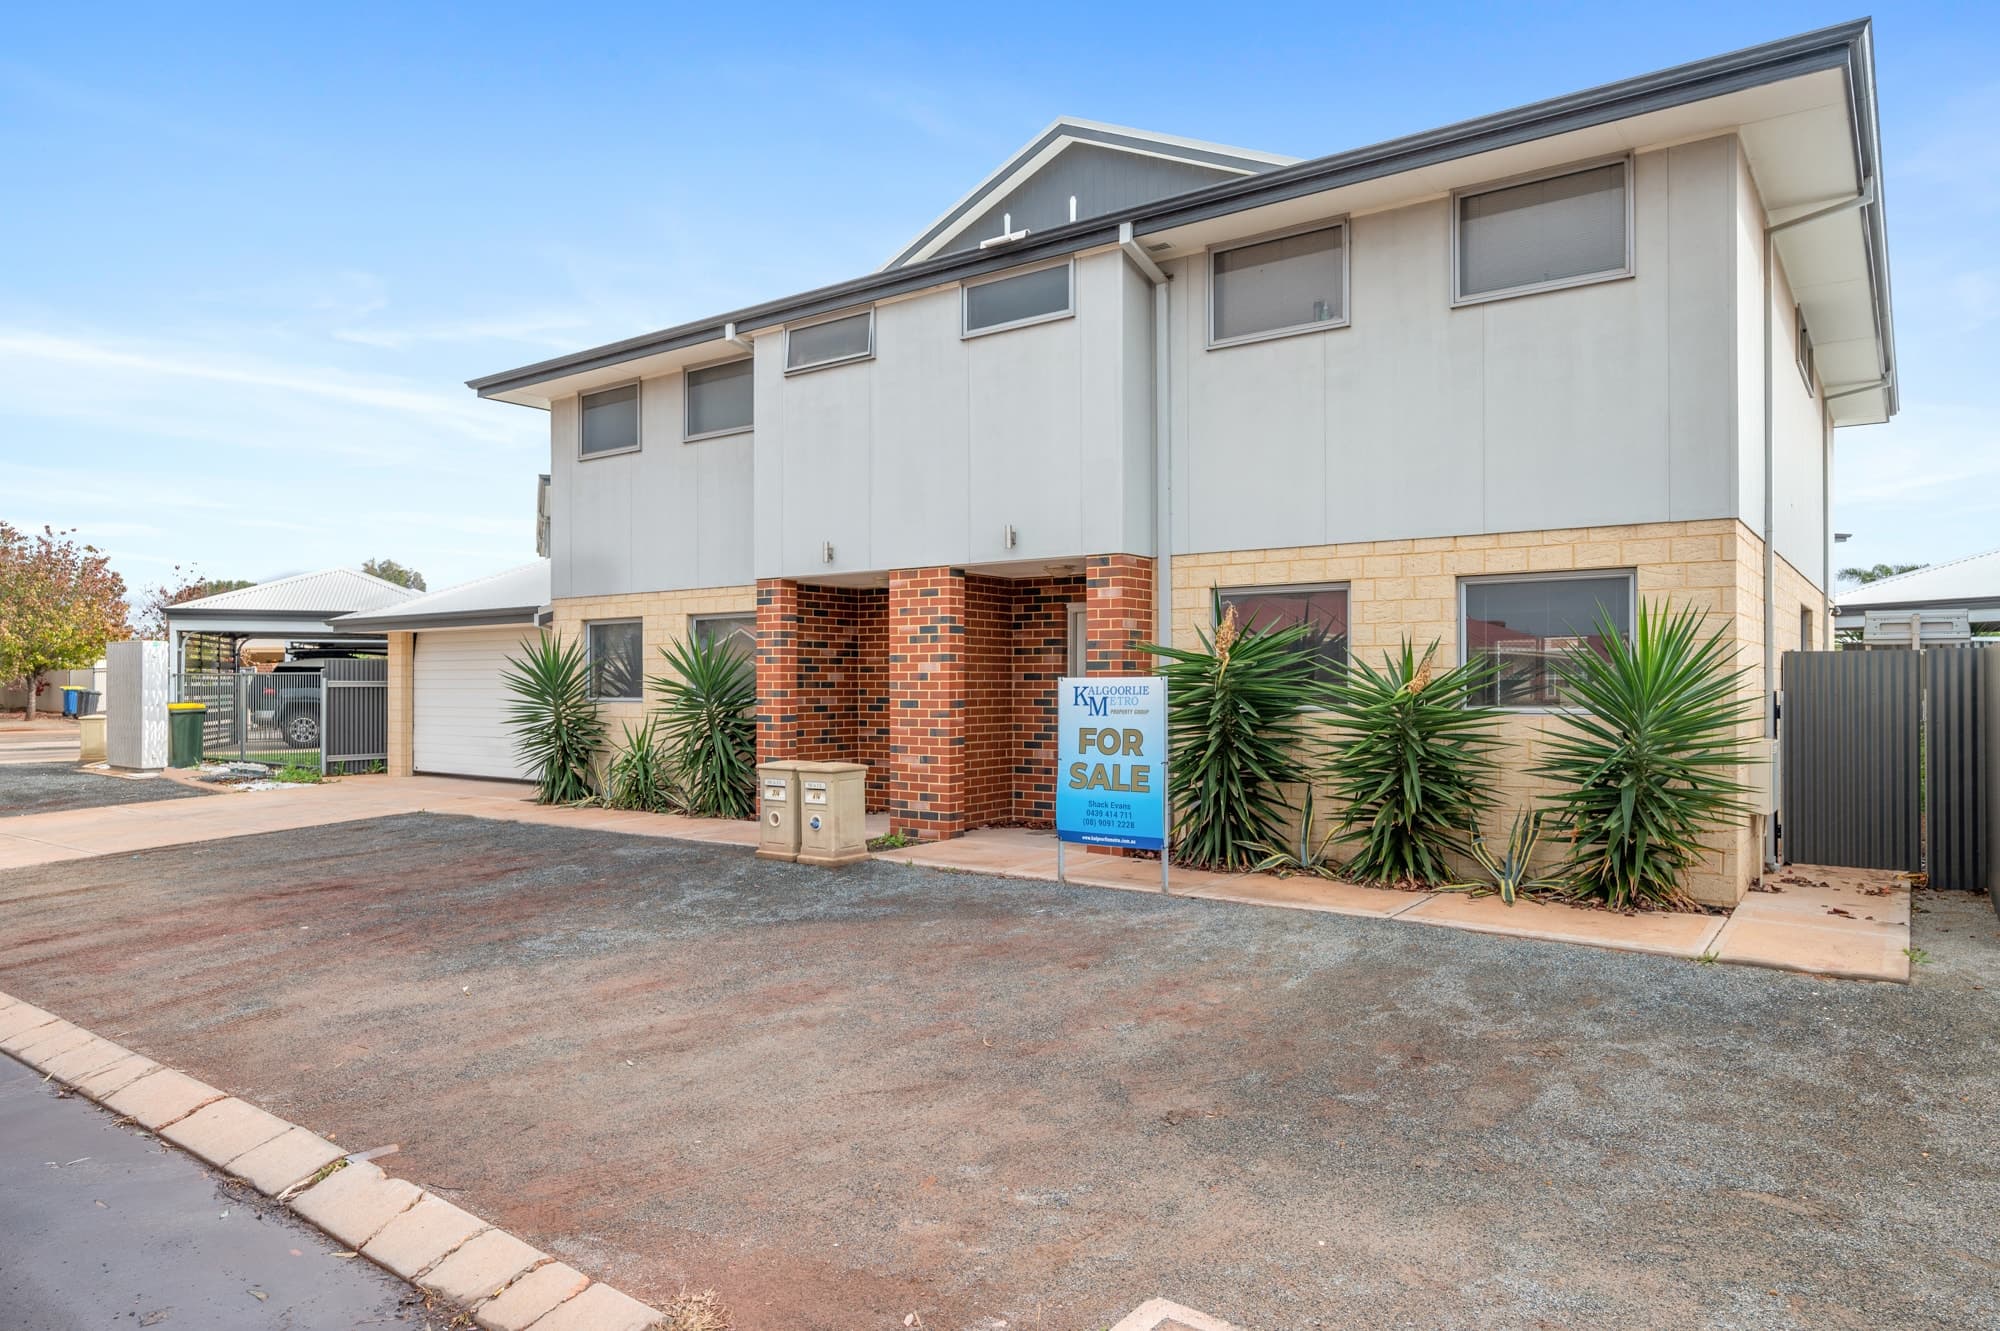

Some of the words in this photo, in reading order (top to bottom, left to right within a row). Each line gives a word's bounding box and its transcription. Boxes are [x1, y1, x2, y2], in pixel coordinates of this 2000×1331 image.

[1073, 686, 1149, 706] KALGOORLIE
[1088, 696, 1139, 716] METRO
[1079, 728, 1144, 756] FOR
[1069, 762, 1150, 793] SALE
